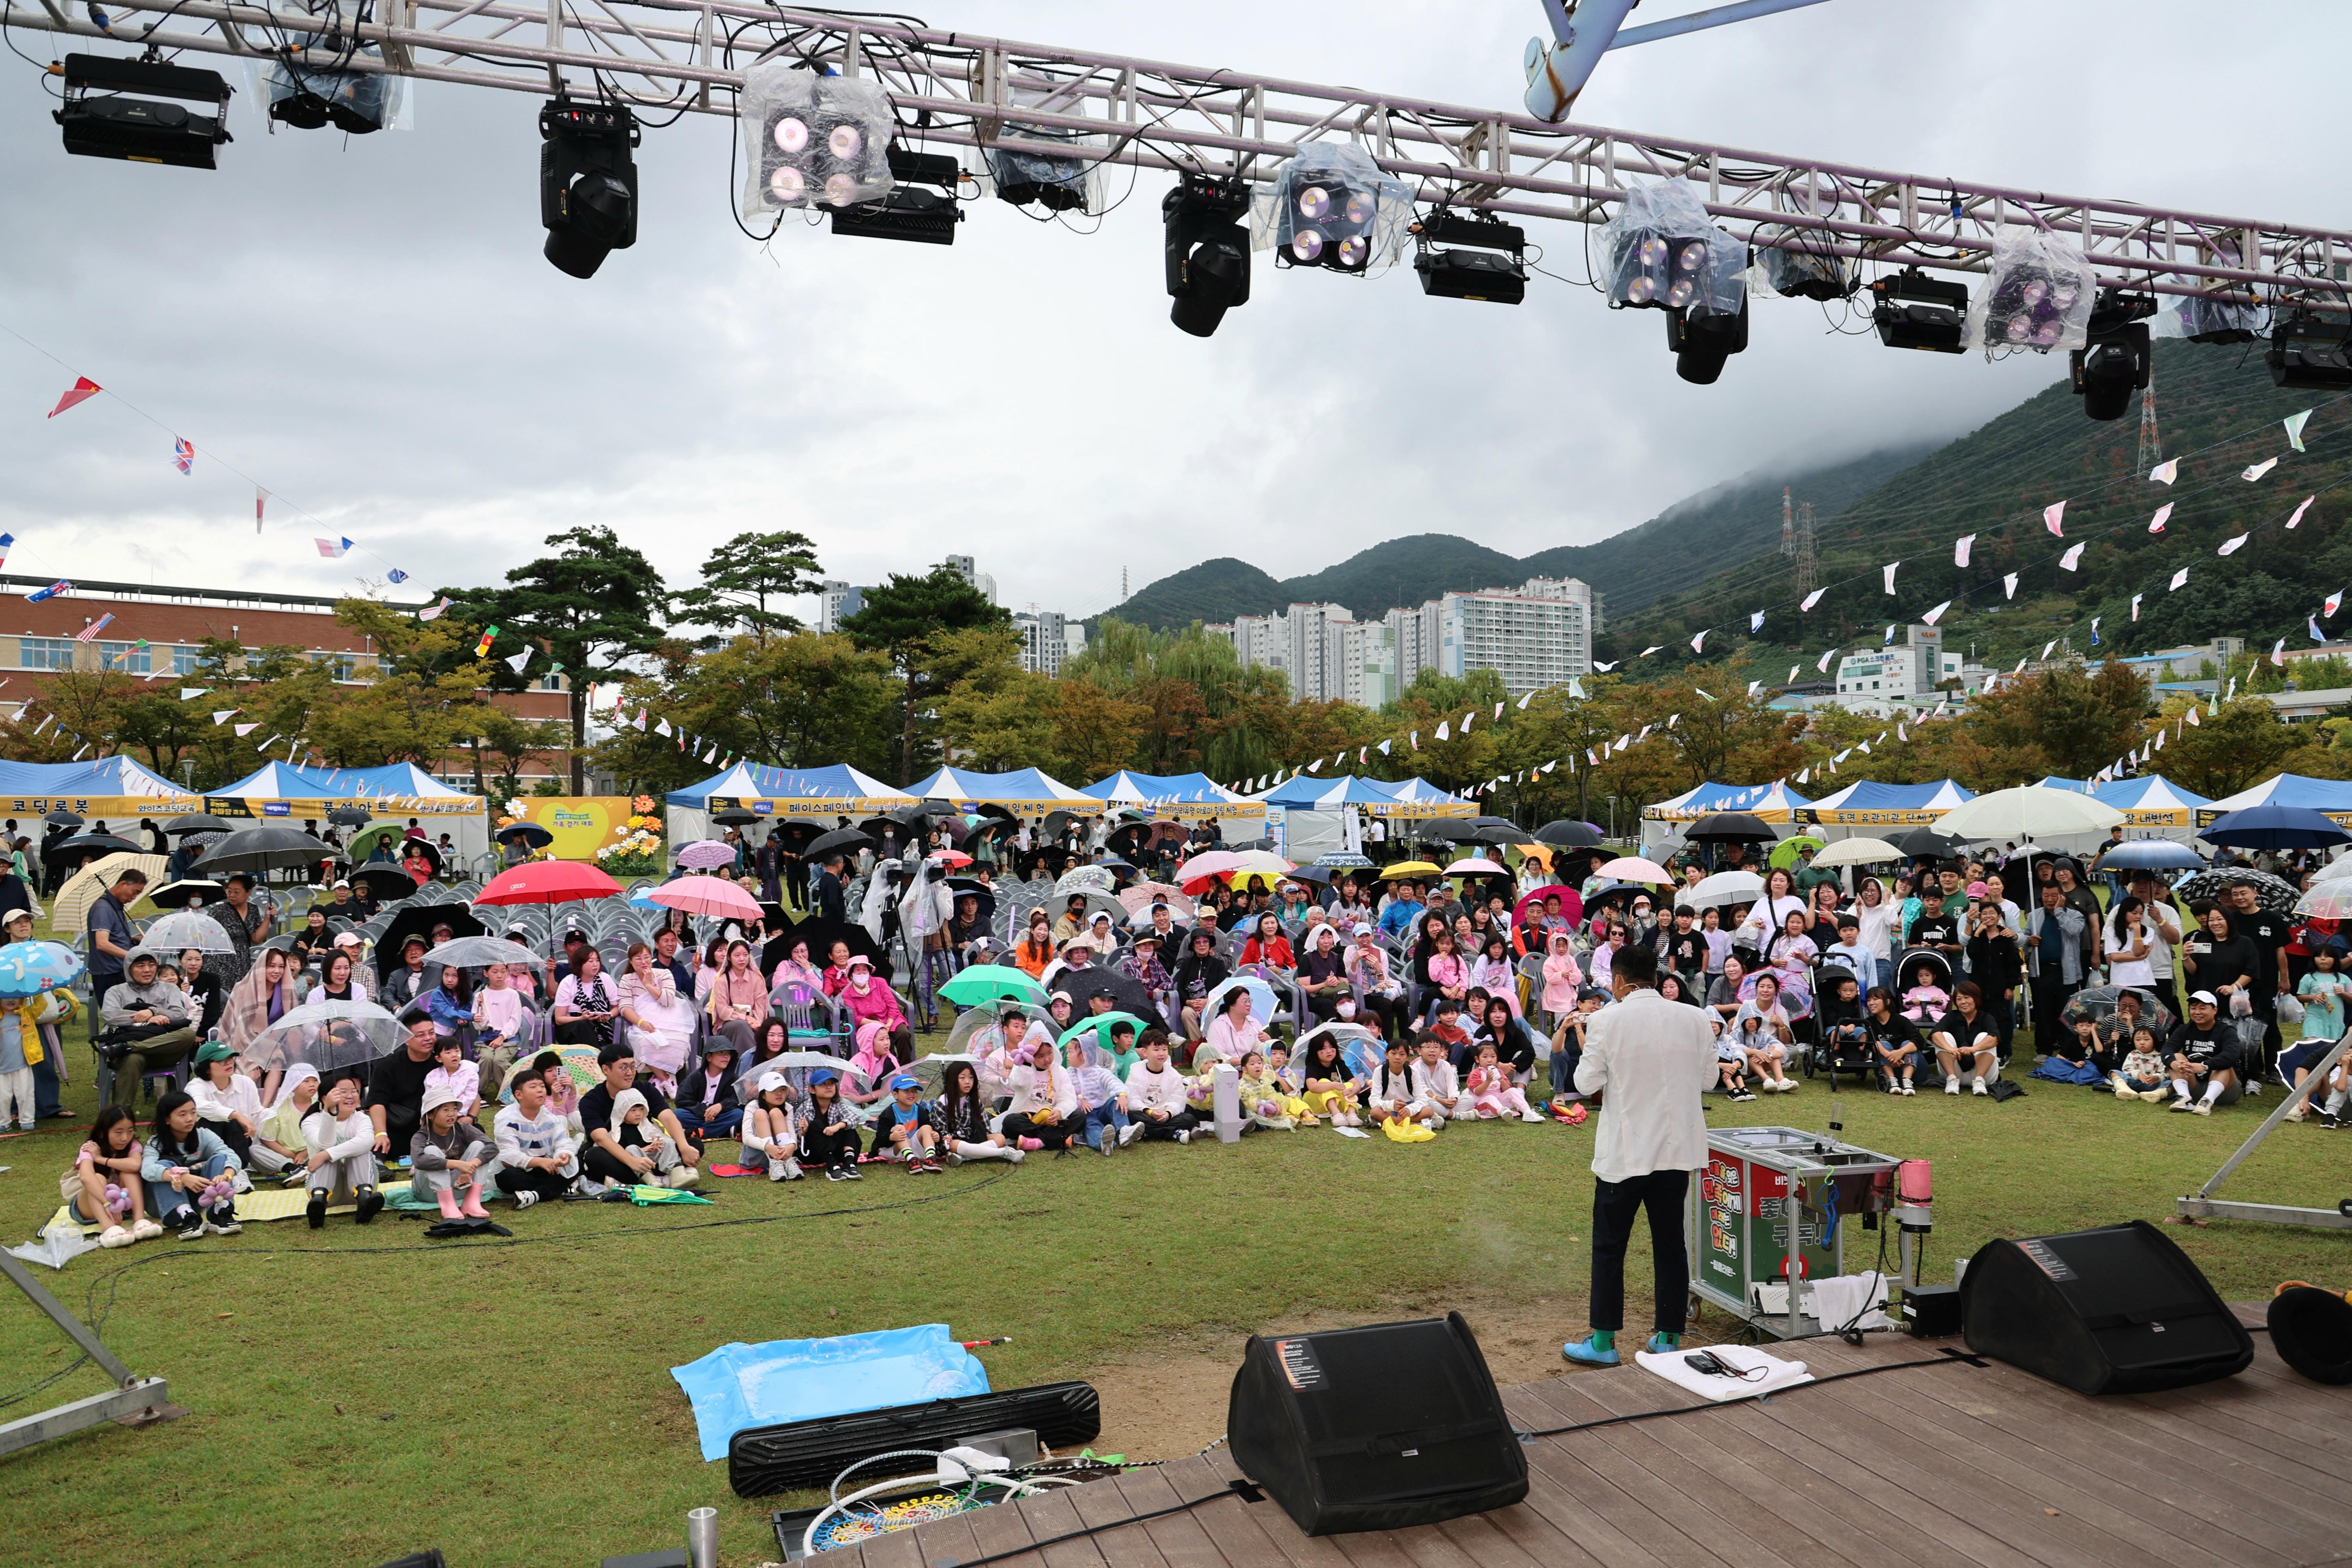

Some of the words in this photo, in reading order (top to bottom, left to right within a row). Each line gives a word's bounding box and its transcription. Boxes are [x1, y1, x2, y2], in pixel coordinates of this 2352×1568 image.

[11, 799, 88, 814] 코딩로봇
[138, 805, 195, 813] 와이즈코딩교육
[789, 803, 855, 814] 페이스페인팅
[1160, 806, 1195, 816] MBTI심리유형
[1196, 806, 1213, 814] 아로마
[1214, 806, 1224, 816] 힐링
[1226, 805, 1237, 816] 체험
[1403, 806, 1436, 816] 한궁체험
[1838, 813, 1855, 823] 동면
[1862, 813, 1900, 824] 유관기관
[1906, 813, 1938, 823] 단체장
[2140, 812, 2173, 825] 내빈석
[1923, 931, 1943, 939] PUMA
[1726, 1167, 1738, 1187] 잊은
[1703, 1178, 1742, 1212] 민족에게
[1710, 1207, 1731, 1229] 미래는
[1711, 1223, 1737, 1258] 없다!
